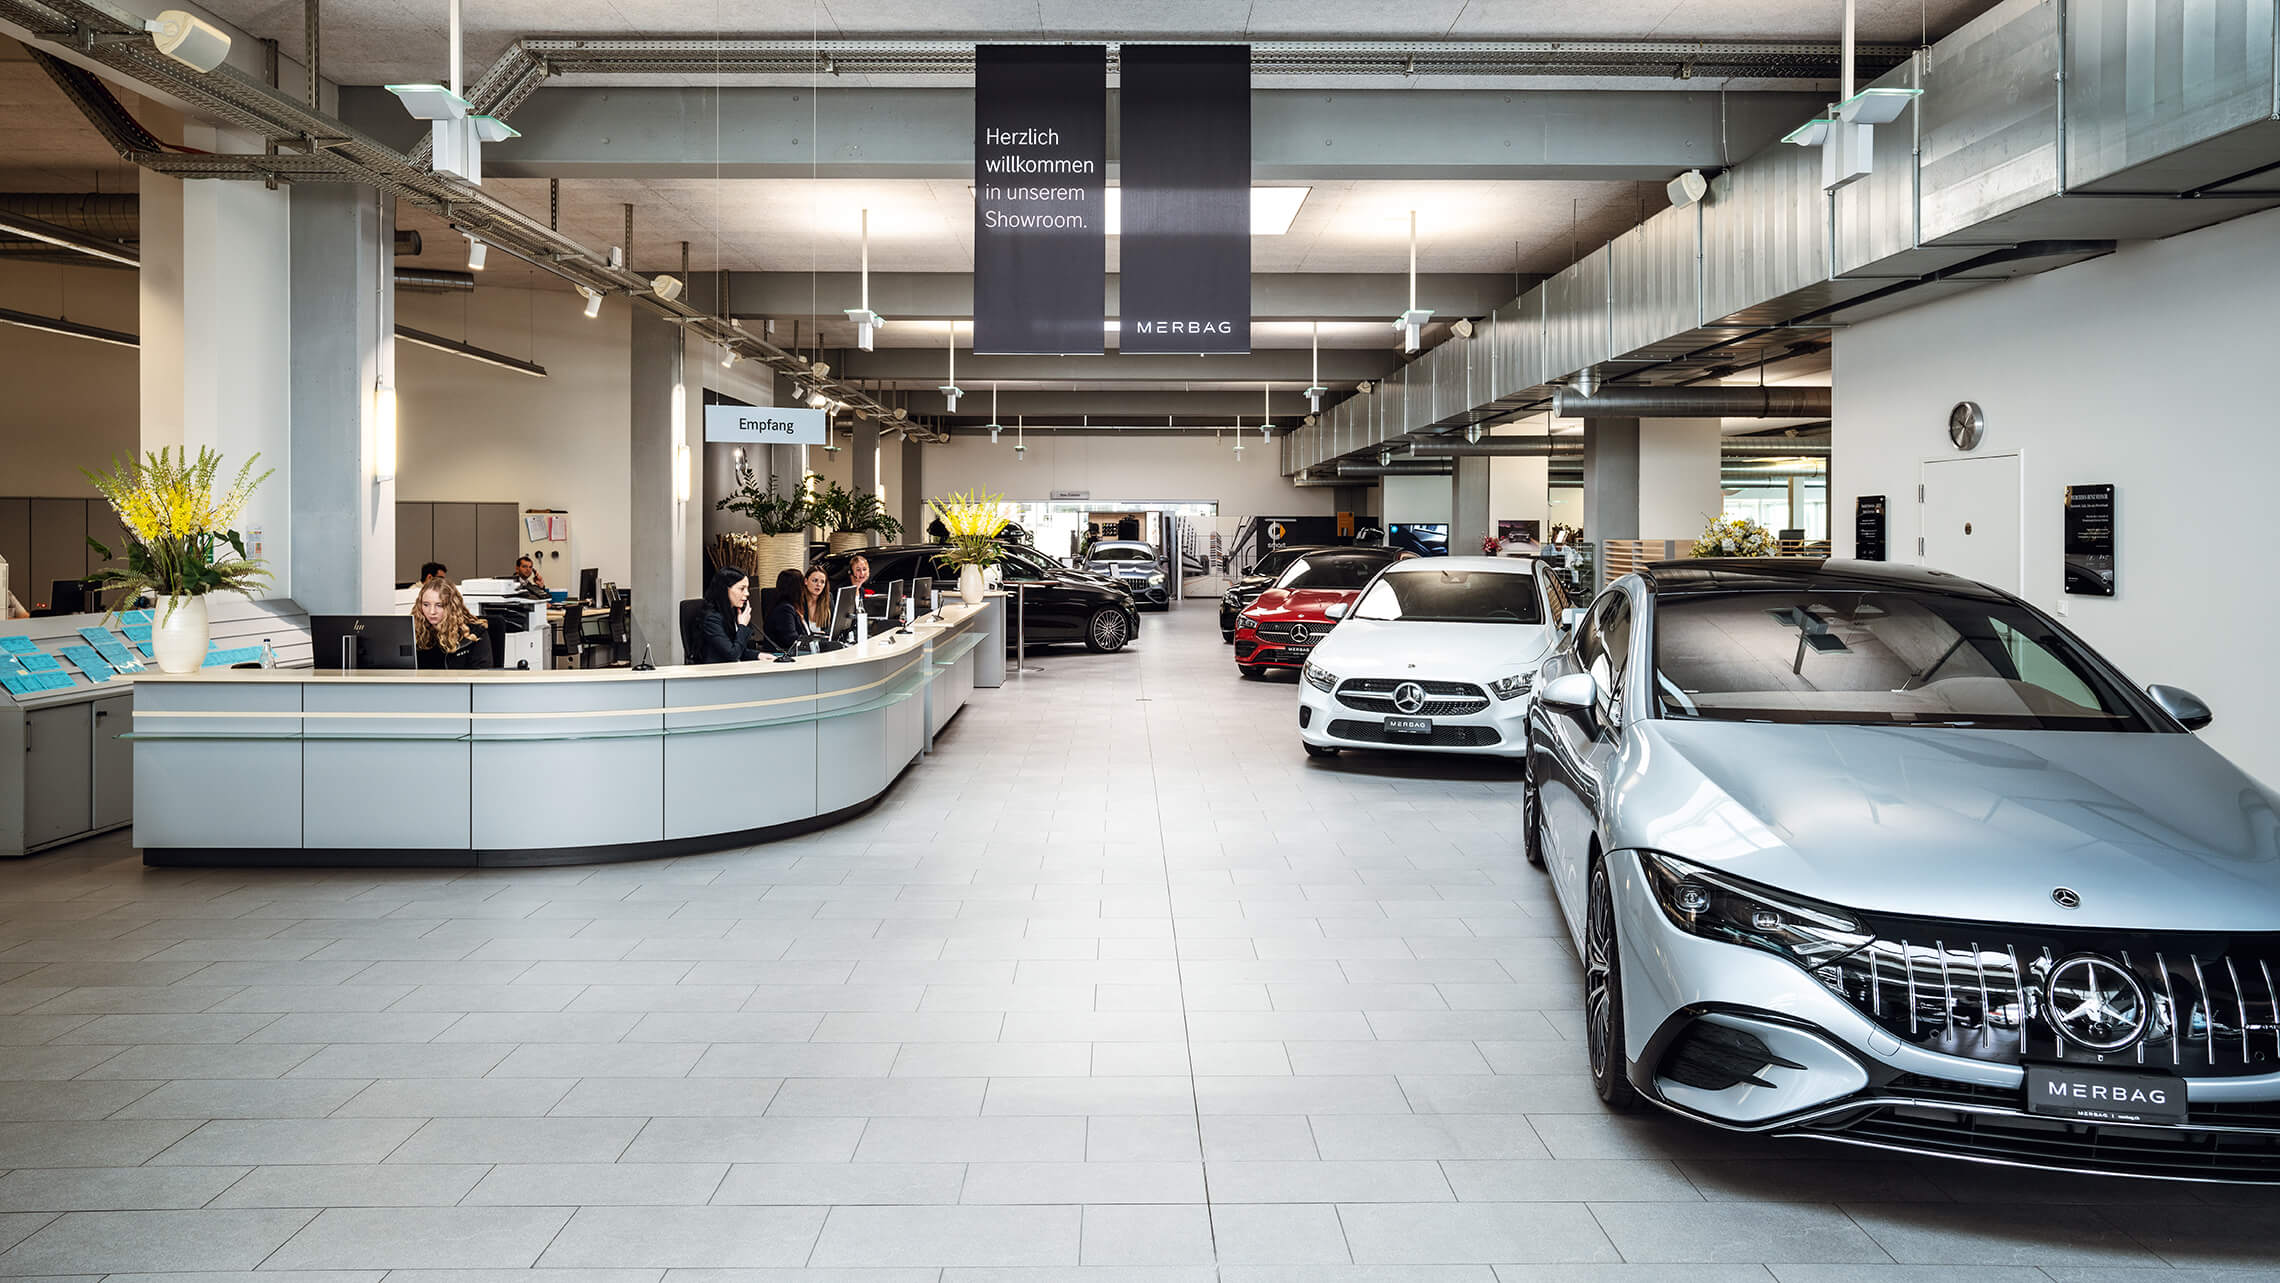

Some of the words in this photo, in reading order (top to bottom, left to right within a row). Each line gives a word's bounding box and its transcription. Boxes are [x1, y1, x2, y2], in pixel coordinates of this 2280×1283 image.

[986, 128, 1059, 145] Herzlich
[985, 155, 1094, 174] willkommen
[985, 184, 1001, 201] in
[1007, 186, 1085, 201] unserem
[985, 210, 1088, 229] Showroom.
[1137, 321, 1232, 334] MERBAG
[739, 418, 795, 435] Empfang
[2048, 1081, 2166, 1104] MERBAG
